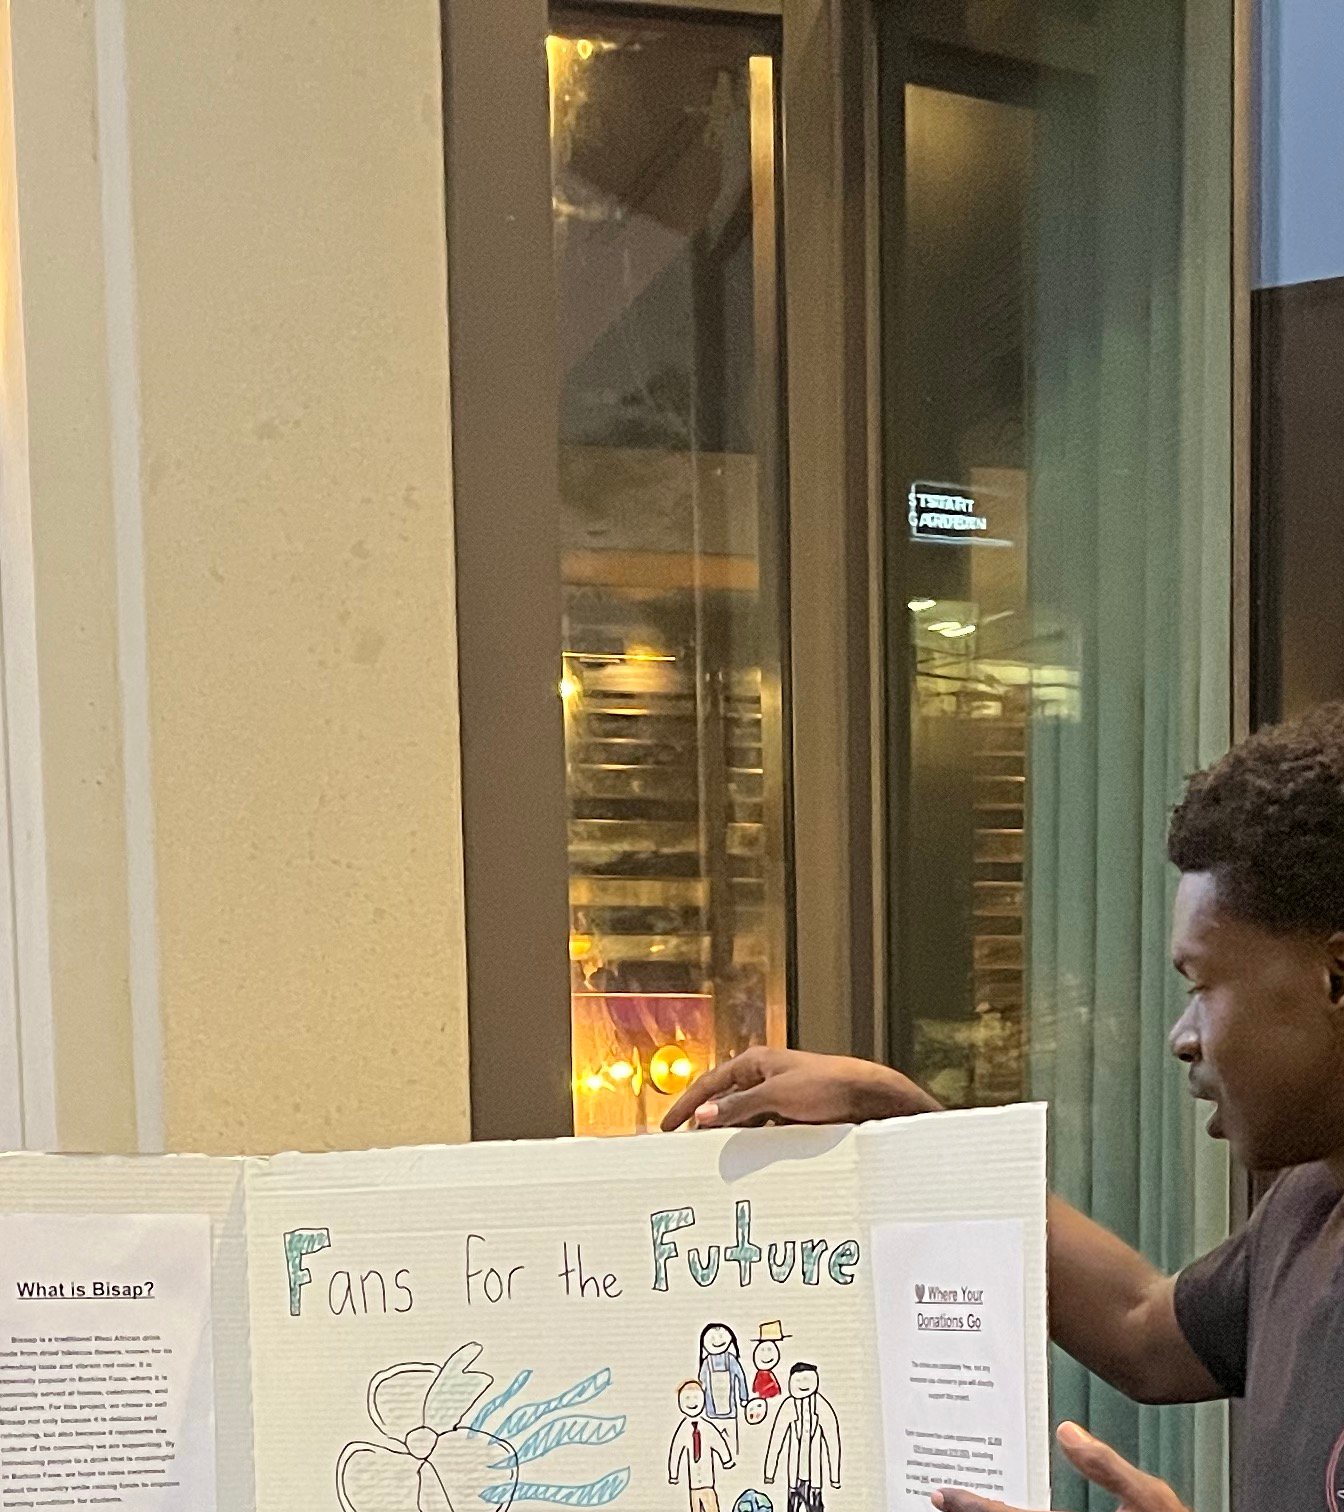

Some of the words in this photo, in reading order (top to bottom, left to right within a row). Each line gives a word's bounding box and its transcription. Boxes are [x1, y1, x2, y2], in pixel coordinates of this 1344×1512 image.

[283, 1228, 413, 1316] Fans
[558, 1241, 623, 1298] the
[650, 1200, 860, 1292] Future
[17, 1281, 65, 1297] What
[71, 1282, 86, 1297] is
[92, 1281, 155, 1300] Bisap?
[928, 1286, 958, 1301] Where
[961, 1286, 983, 1301] Your
[917, 1312, 964, 1329] Donations
[967, 1313, 981, 1329] Go
